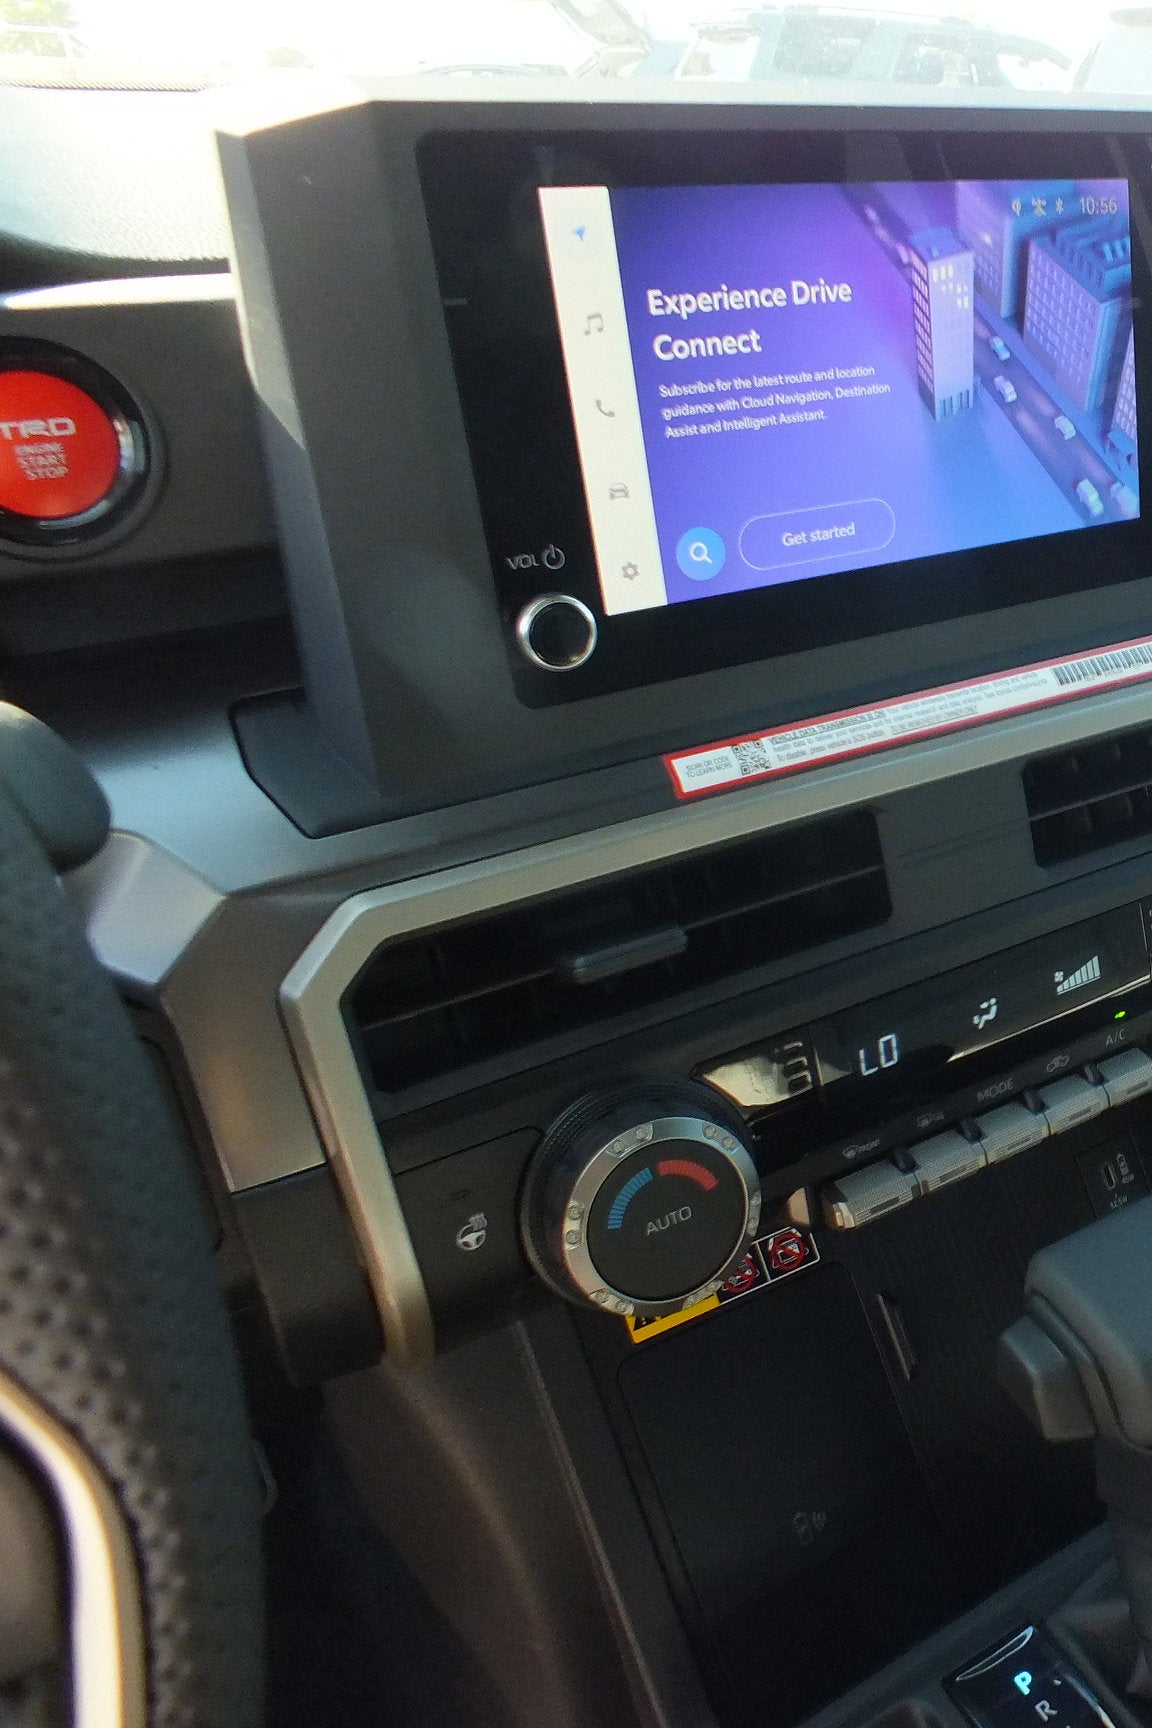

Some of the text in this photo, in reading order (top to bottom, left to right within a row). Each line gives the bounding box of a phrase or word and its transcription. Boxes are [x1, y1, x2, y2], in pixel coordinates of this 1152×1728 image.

[1080, 197, 1118, 215] 10:56
[647, 278, 852, 320] Experience Drive
[653, 329, 763, 361] Connect
[659, 366, 876, 398] Subscribe for the latest route and location
[663, 383, 891, 421] guidance with Cloud Navigation, Destination
[0, 417, 77, 440] TRD
[665, 409, 828, 439] Assist and Intelligent Assistant.
[782, 521, 856, 547] Get started
[506, 553, 540, 569] VOL
[1105, 1028, 1127, 1046] A/C
[976, 1079, 1015, 1102] MODE
[646, 1206, 693, 1236] AUTO
[1014, 1671, 1032, 1696] P
[1035, 1700, 1058, 1722] R
